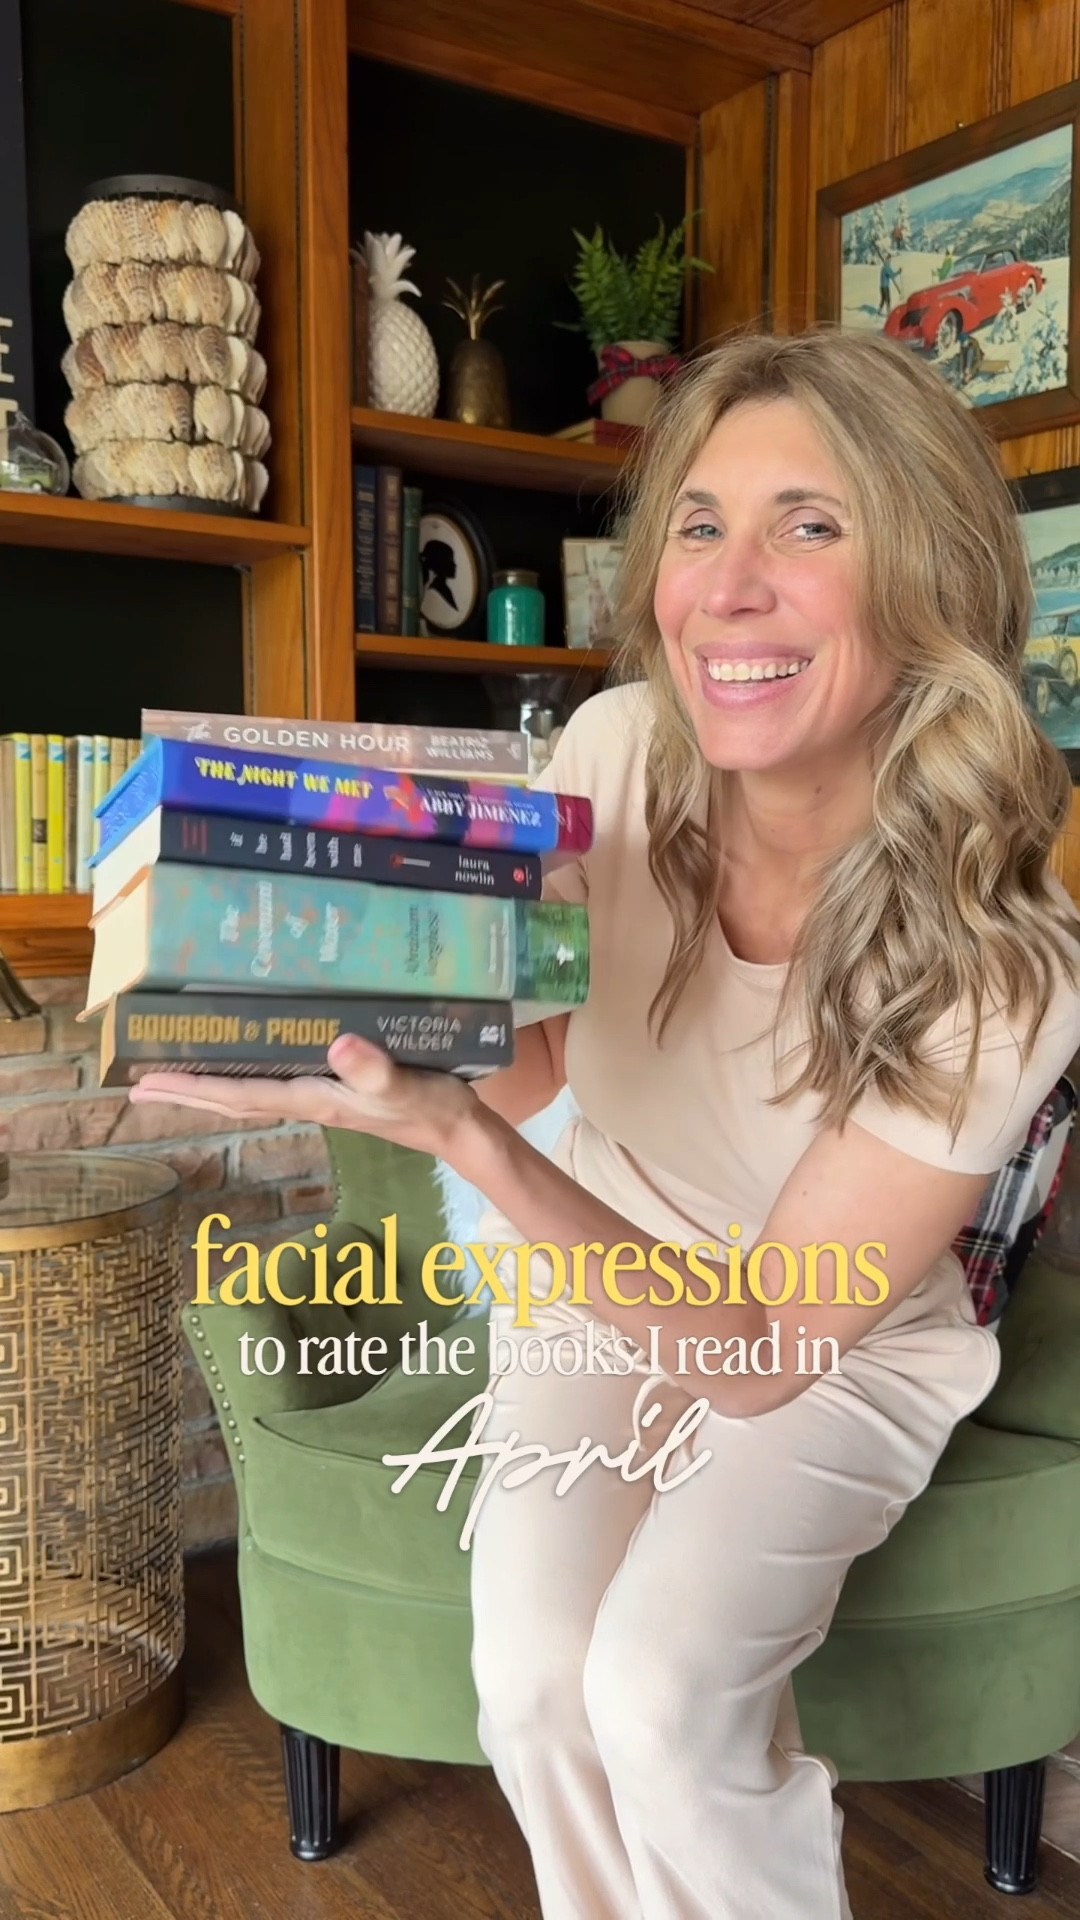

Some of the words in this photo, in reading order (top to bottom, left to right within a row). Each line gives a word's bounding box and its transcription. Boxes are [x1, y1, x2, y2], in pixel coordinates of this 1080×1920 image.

[223, 726, 329, 748] GOLDEN
[339, 733, 410, 753] HOUR
[194, 756, 236, 781] THE
[236, 764, 298, 789] NIGHT
[302, 772, 330, 793] WE
[334, 776, 373, 799] MET
[458, 855, 490, 871] laura
[455, 870, 495, 886] nowlin
[127, 1013, 240, 1044] BOURBON
[243, 1020, 261, 1043] &
[265, 1017, 341, 1047] PROOF
[376, 1015, 462, 1034] VICTORIA
[384, 1033, 455, 1051] WILDER
